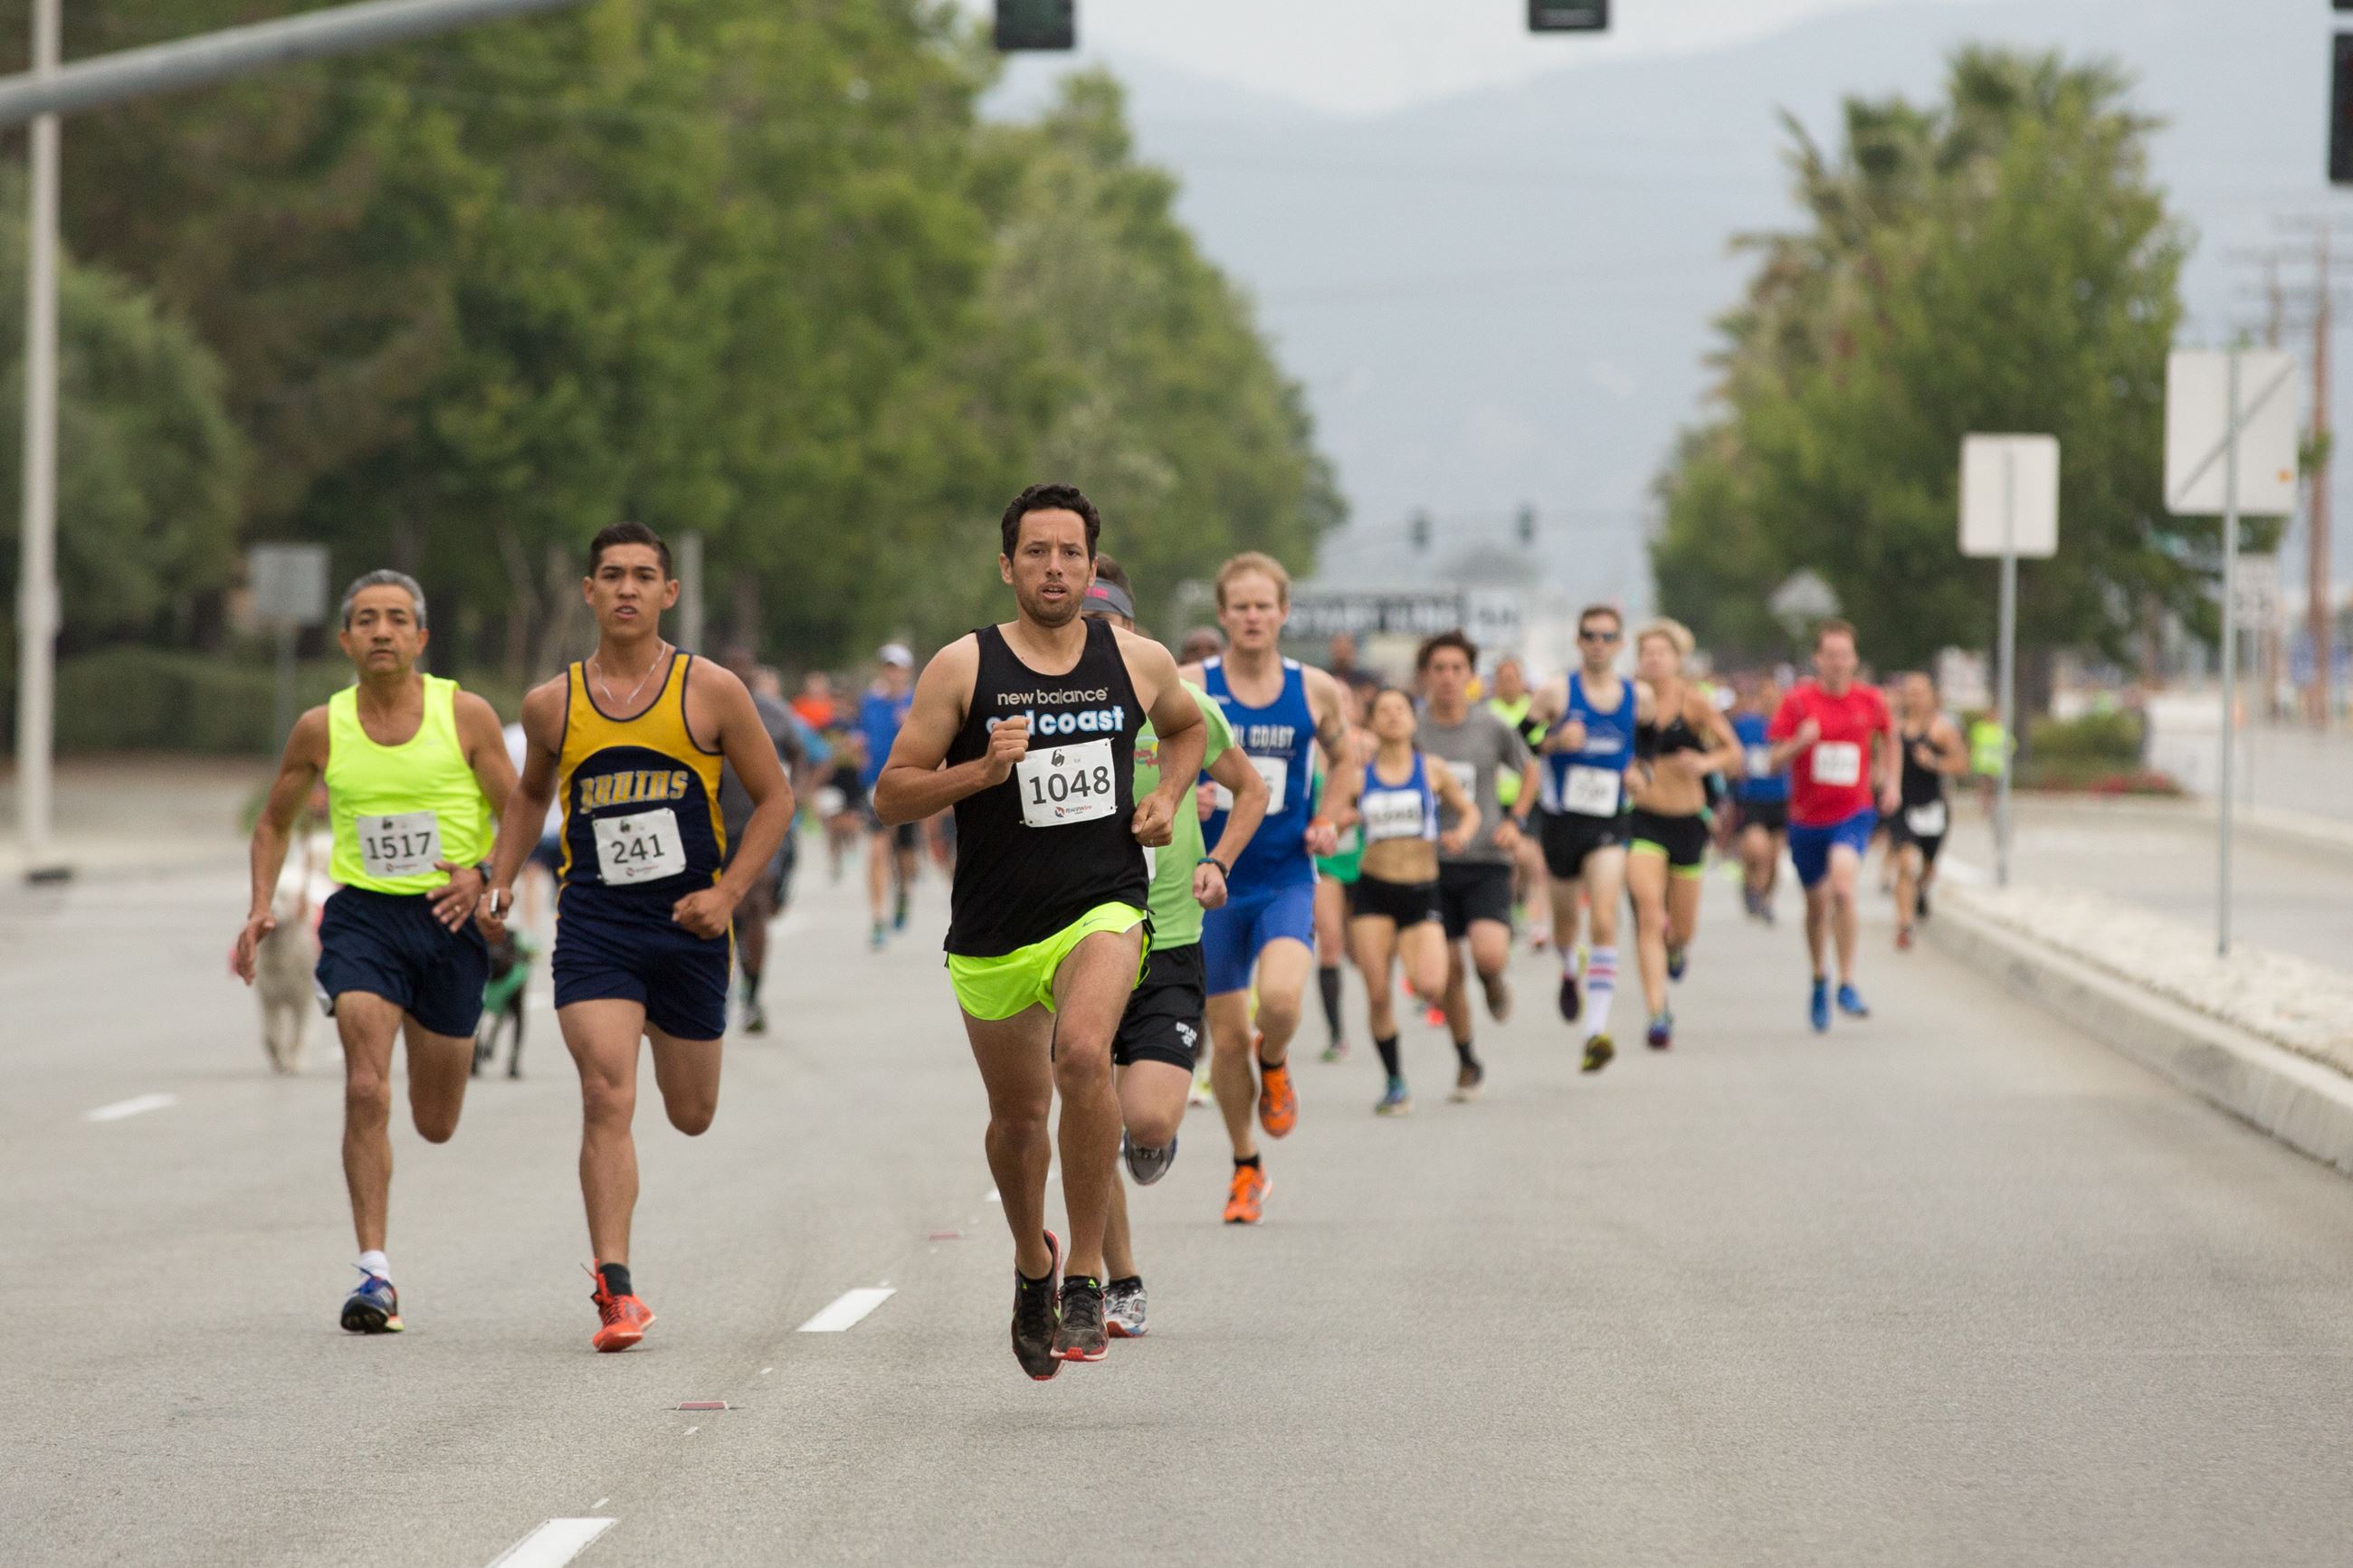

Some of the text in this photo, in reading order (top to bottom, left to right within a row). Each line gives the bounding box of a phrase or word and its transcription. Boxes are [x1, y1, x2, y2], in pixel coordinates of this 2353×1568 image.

[997, 688, 1108, 705] new balance
[1039, 706, 1124, 735] coast
[1249, 724, 1295, 748] COAST
[580, 770, 689, 814] BRUINS
[1029, 766, 1110, 804] 1048
[367, 832, 431, 860] 1517
[611, 833, 665, 864] 241
